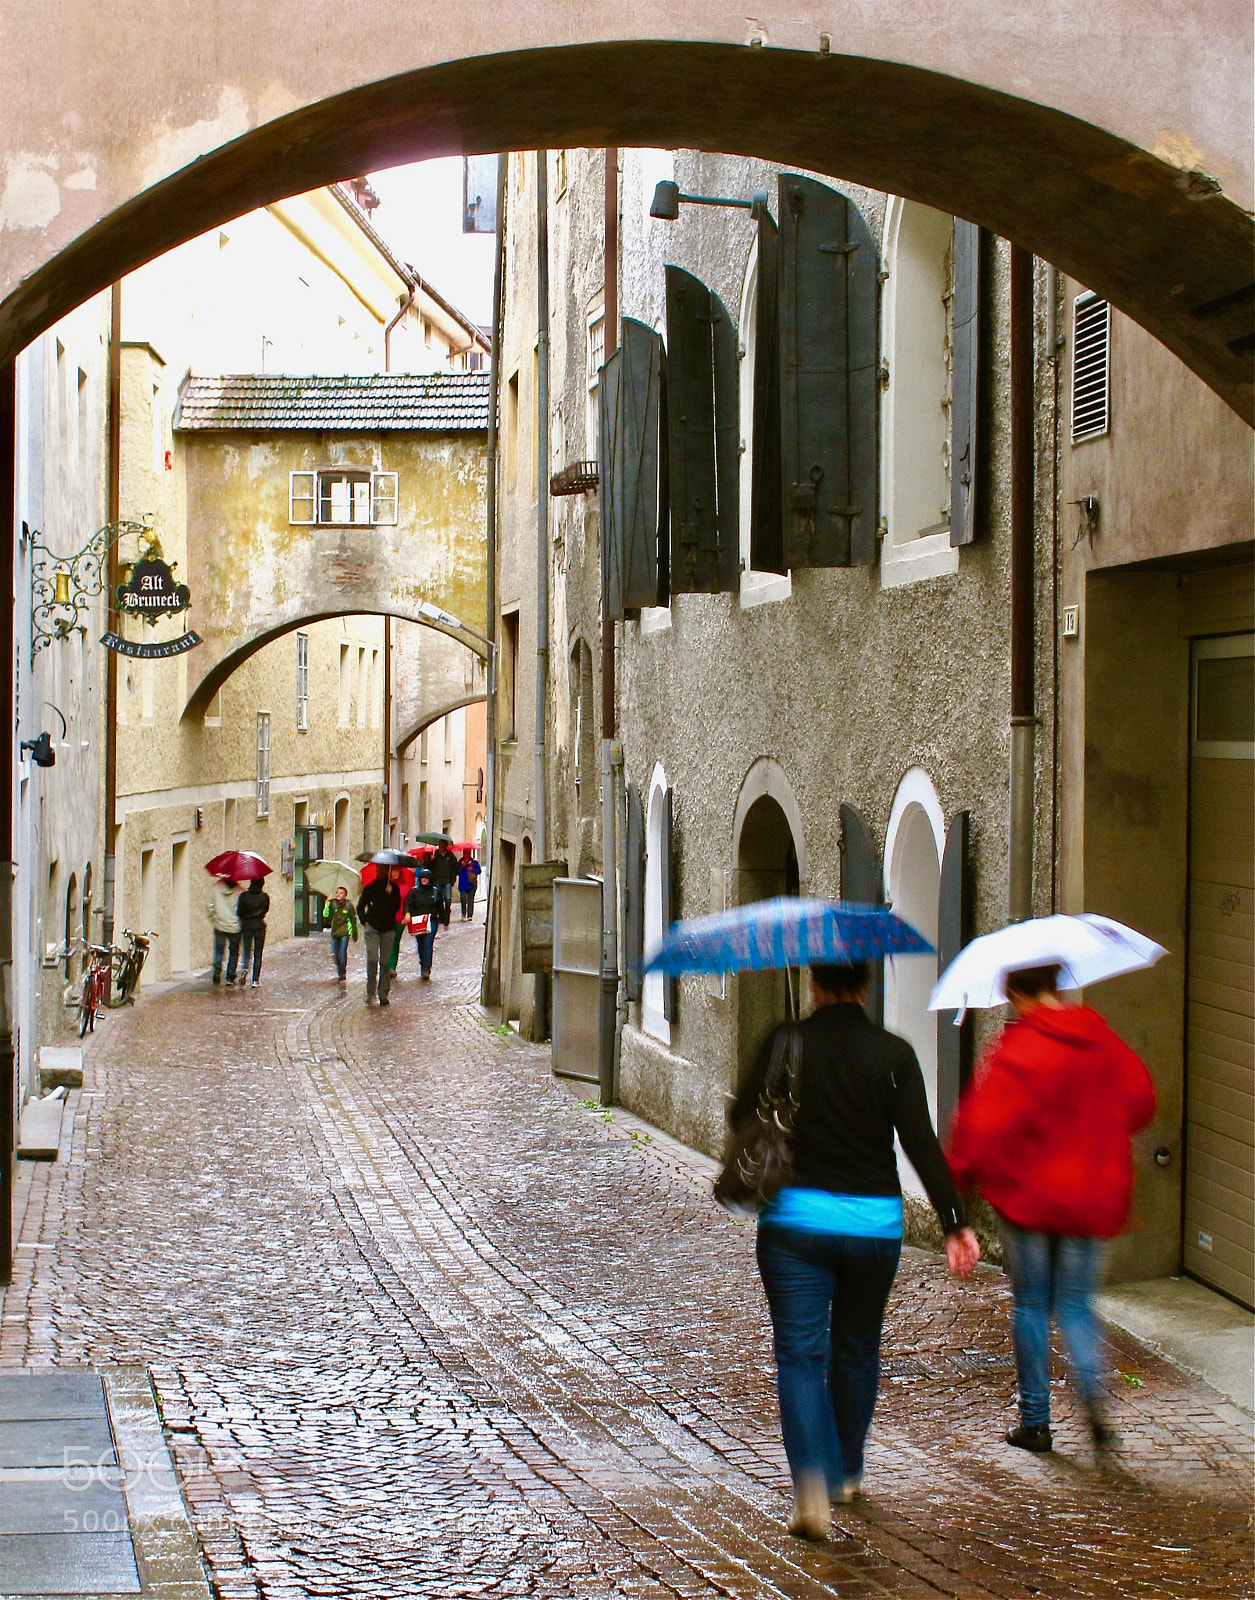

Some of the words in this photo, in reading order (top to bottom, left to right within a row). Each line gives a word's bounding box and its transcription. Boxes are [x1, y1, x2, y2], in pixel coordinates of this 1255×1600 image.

[141, 575, 164, 591] Alt
[123, 592, 181, 609] Bruneck
[104, 634, 197, 657] Restaurant
